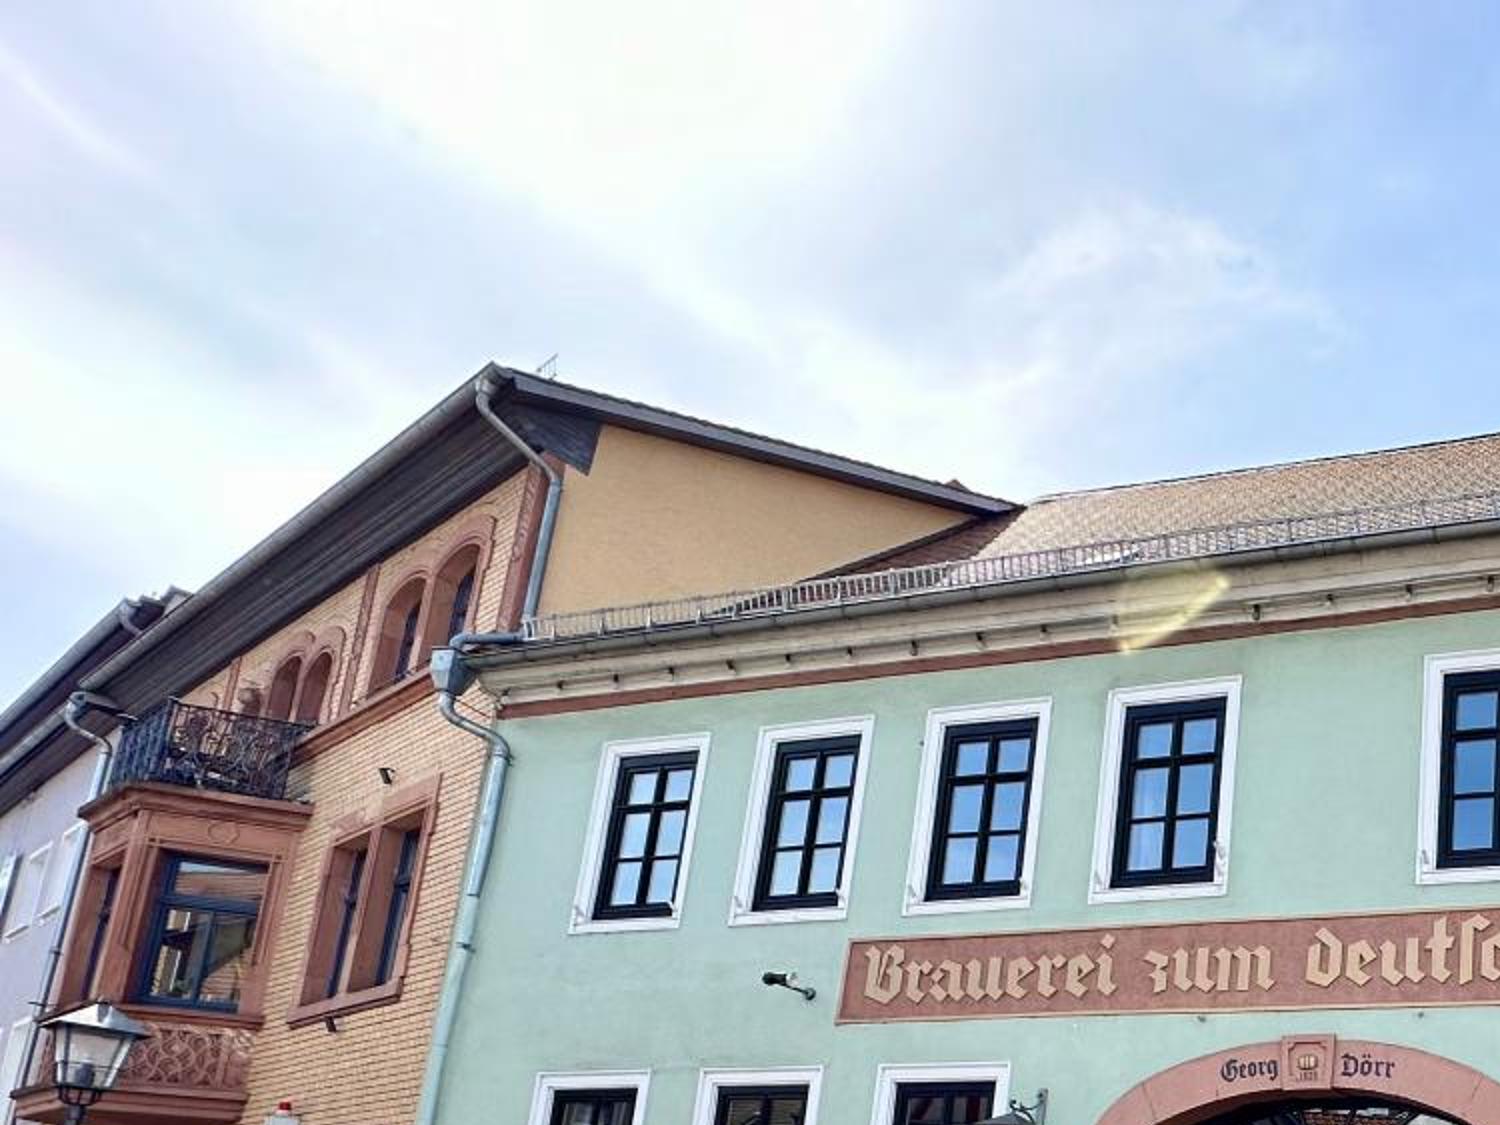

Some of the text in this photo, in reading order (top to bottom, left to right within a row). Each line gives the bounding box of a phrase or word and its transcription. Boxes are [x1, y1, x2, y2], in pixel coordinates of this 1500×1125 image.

[863, 934, 1118, 1003] Brauerei
[1144, 944, 1276, 993] zum
[1220, 1053, 1396, 1082] Georg Dörr
